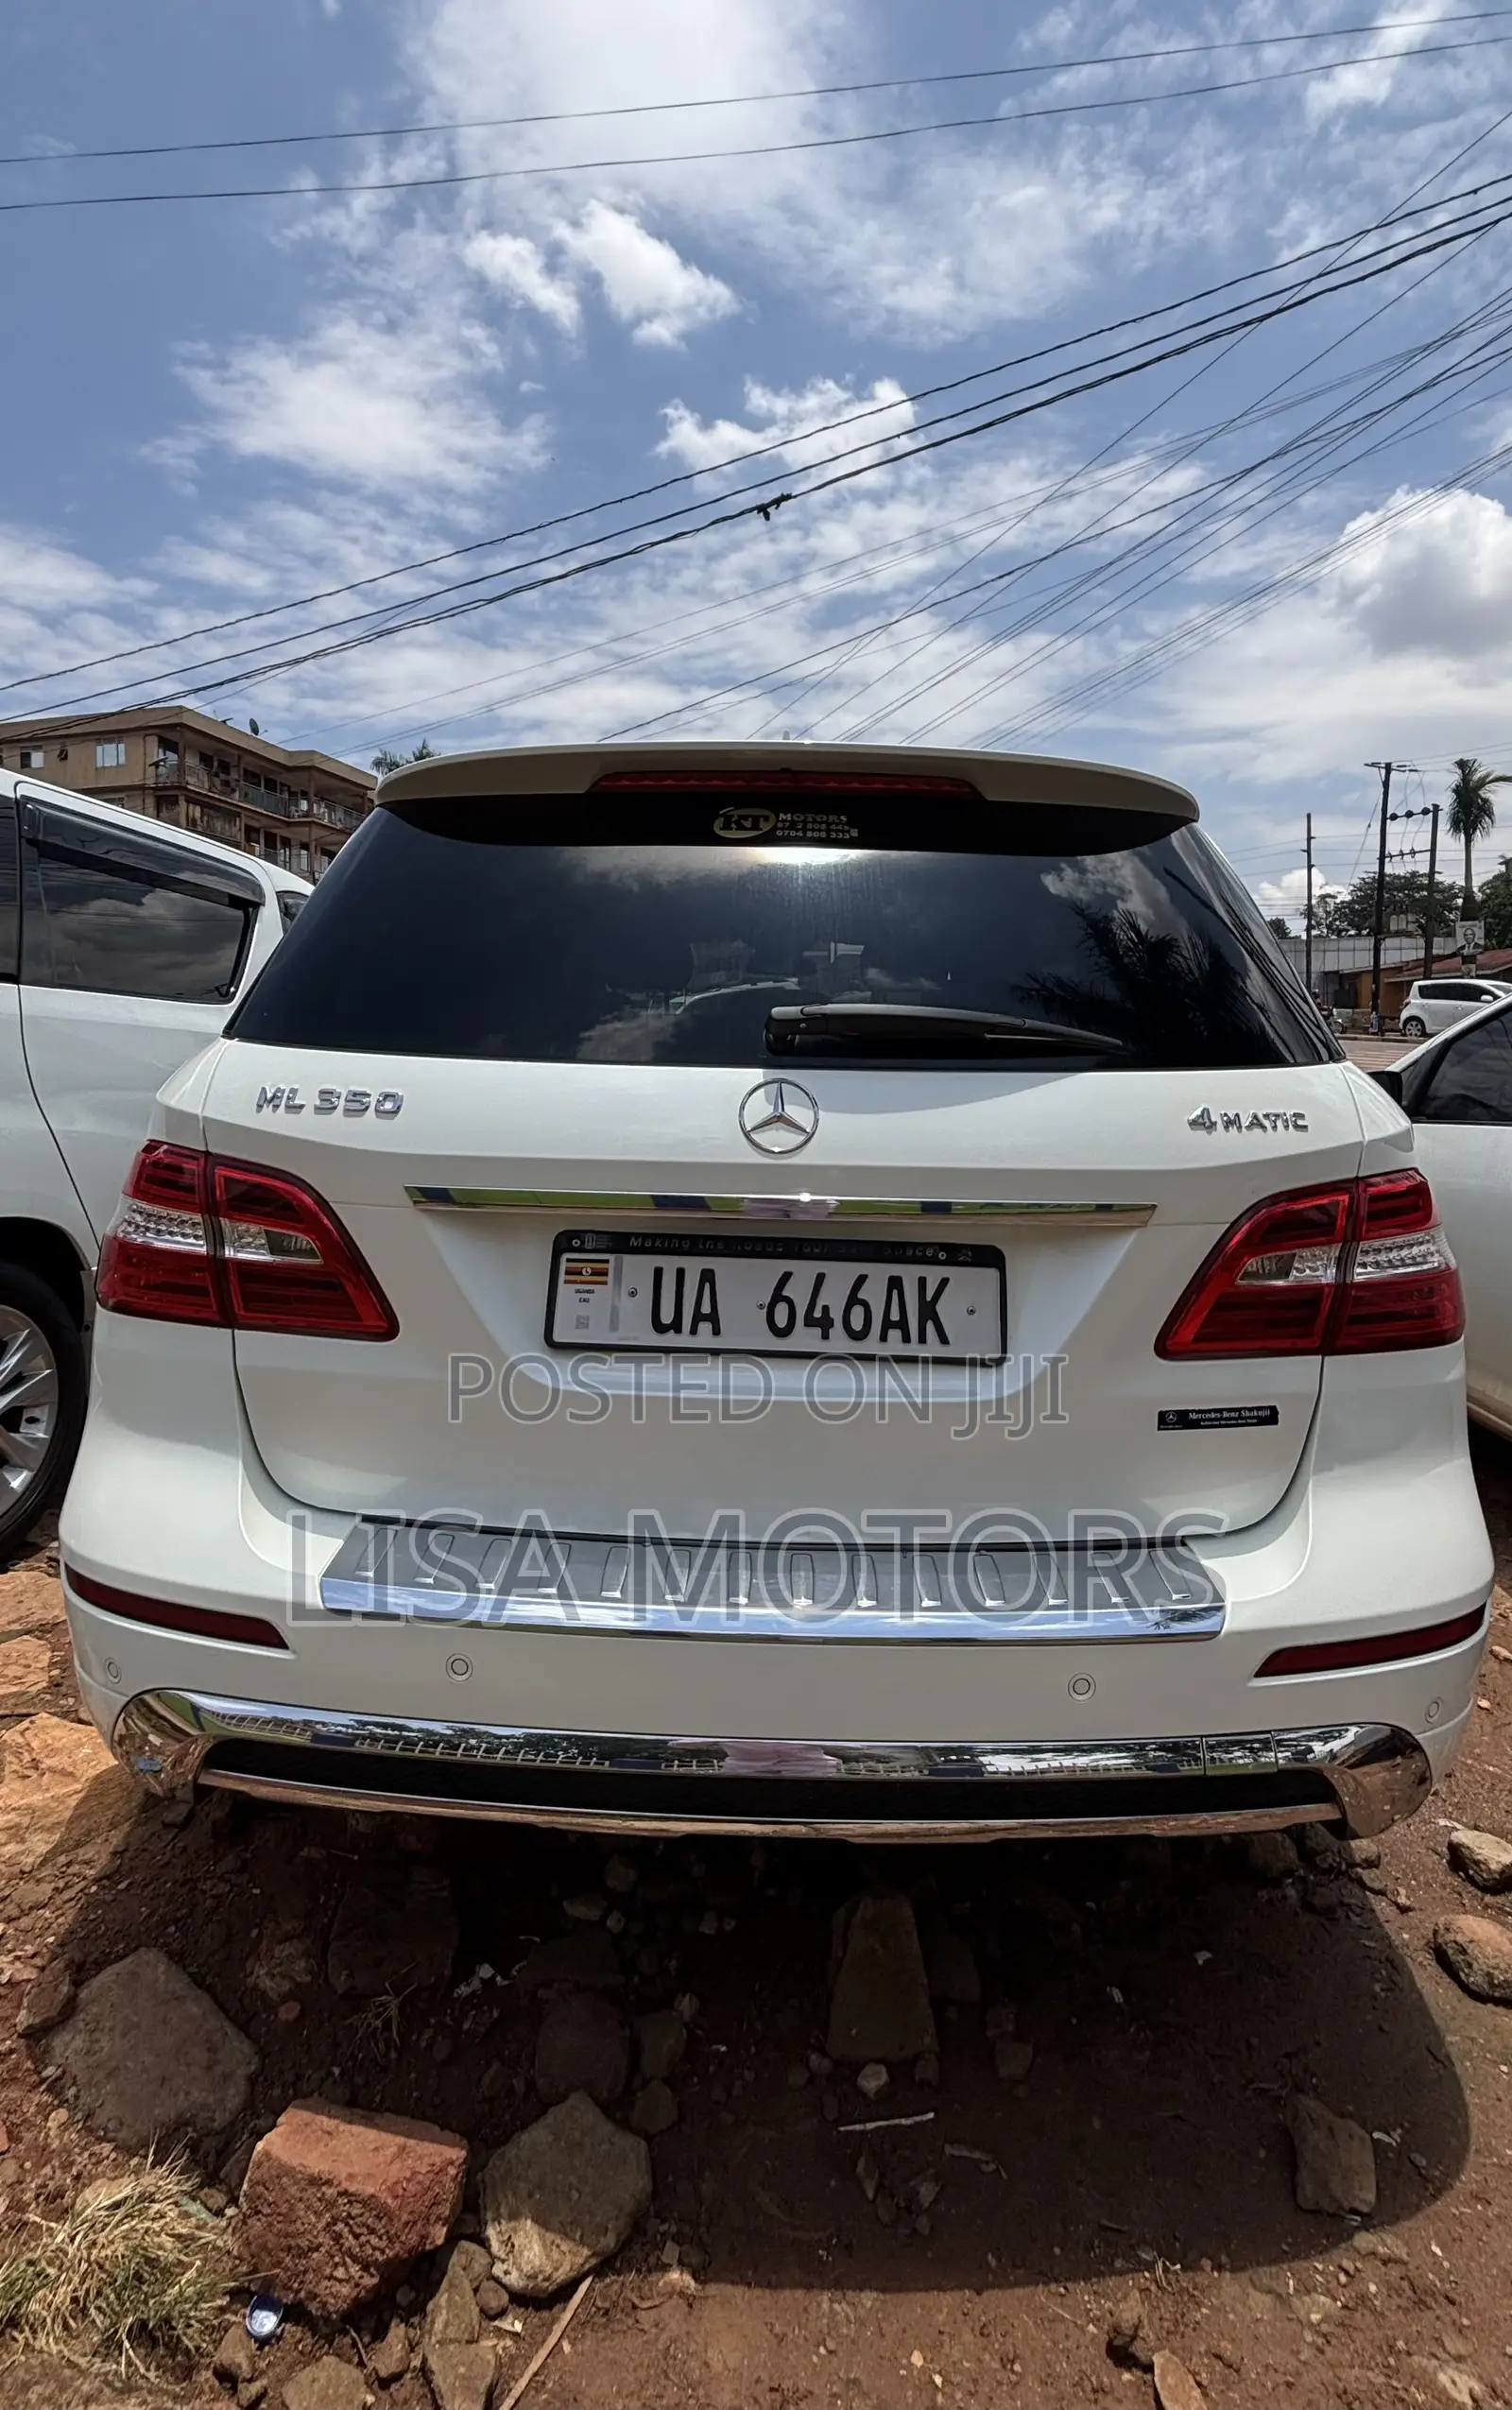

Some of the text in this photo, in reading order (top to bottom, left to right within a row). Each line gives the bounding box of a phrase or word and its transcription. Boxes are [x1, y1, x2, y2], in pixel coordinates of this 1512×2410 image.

[779, 813, 848, 823] MOTORS
[256, 1085, 404, 1120] ML 350
[1187, 1105, 1309, 1134] 4MATIC
[629, 1235, 690, 1250] Making
[651, 1266, 950, 1344] UA 646AK
[1188, 1410, 1240, 1420] Mercedes-Benz
